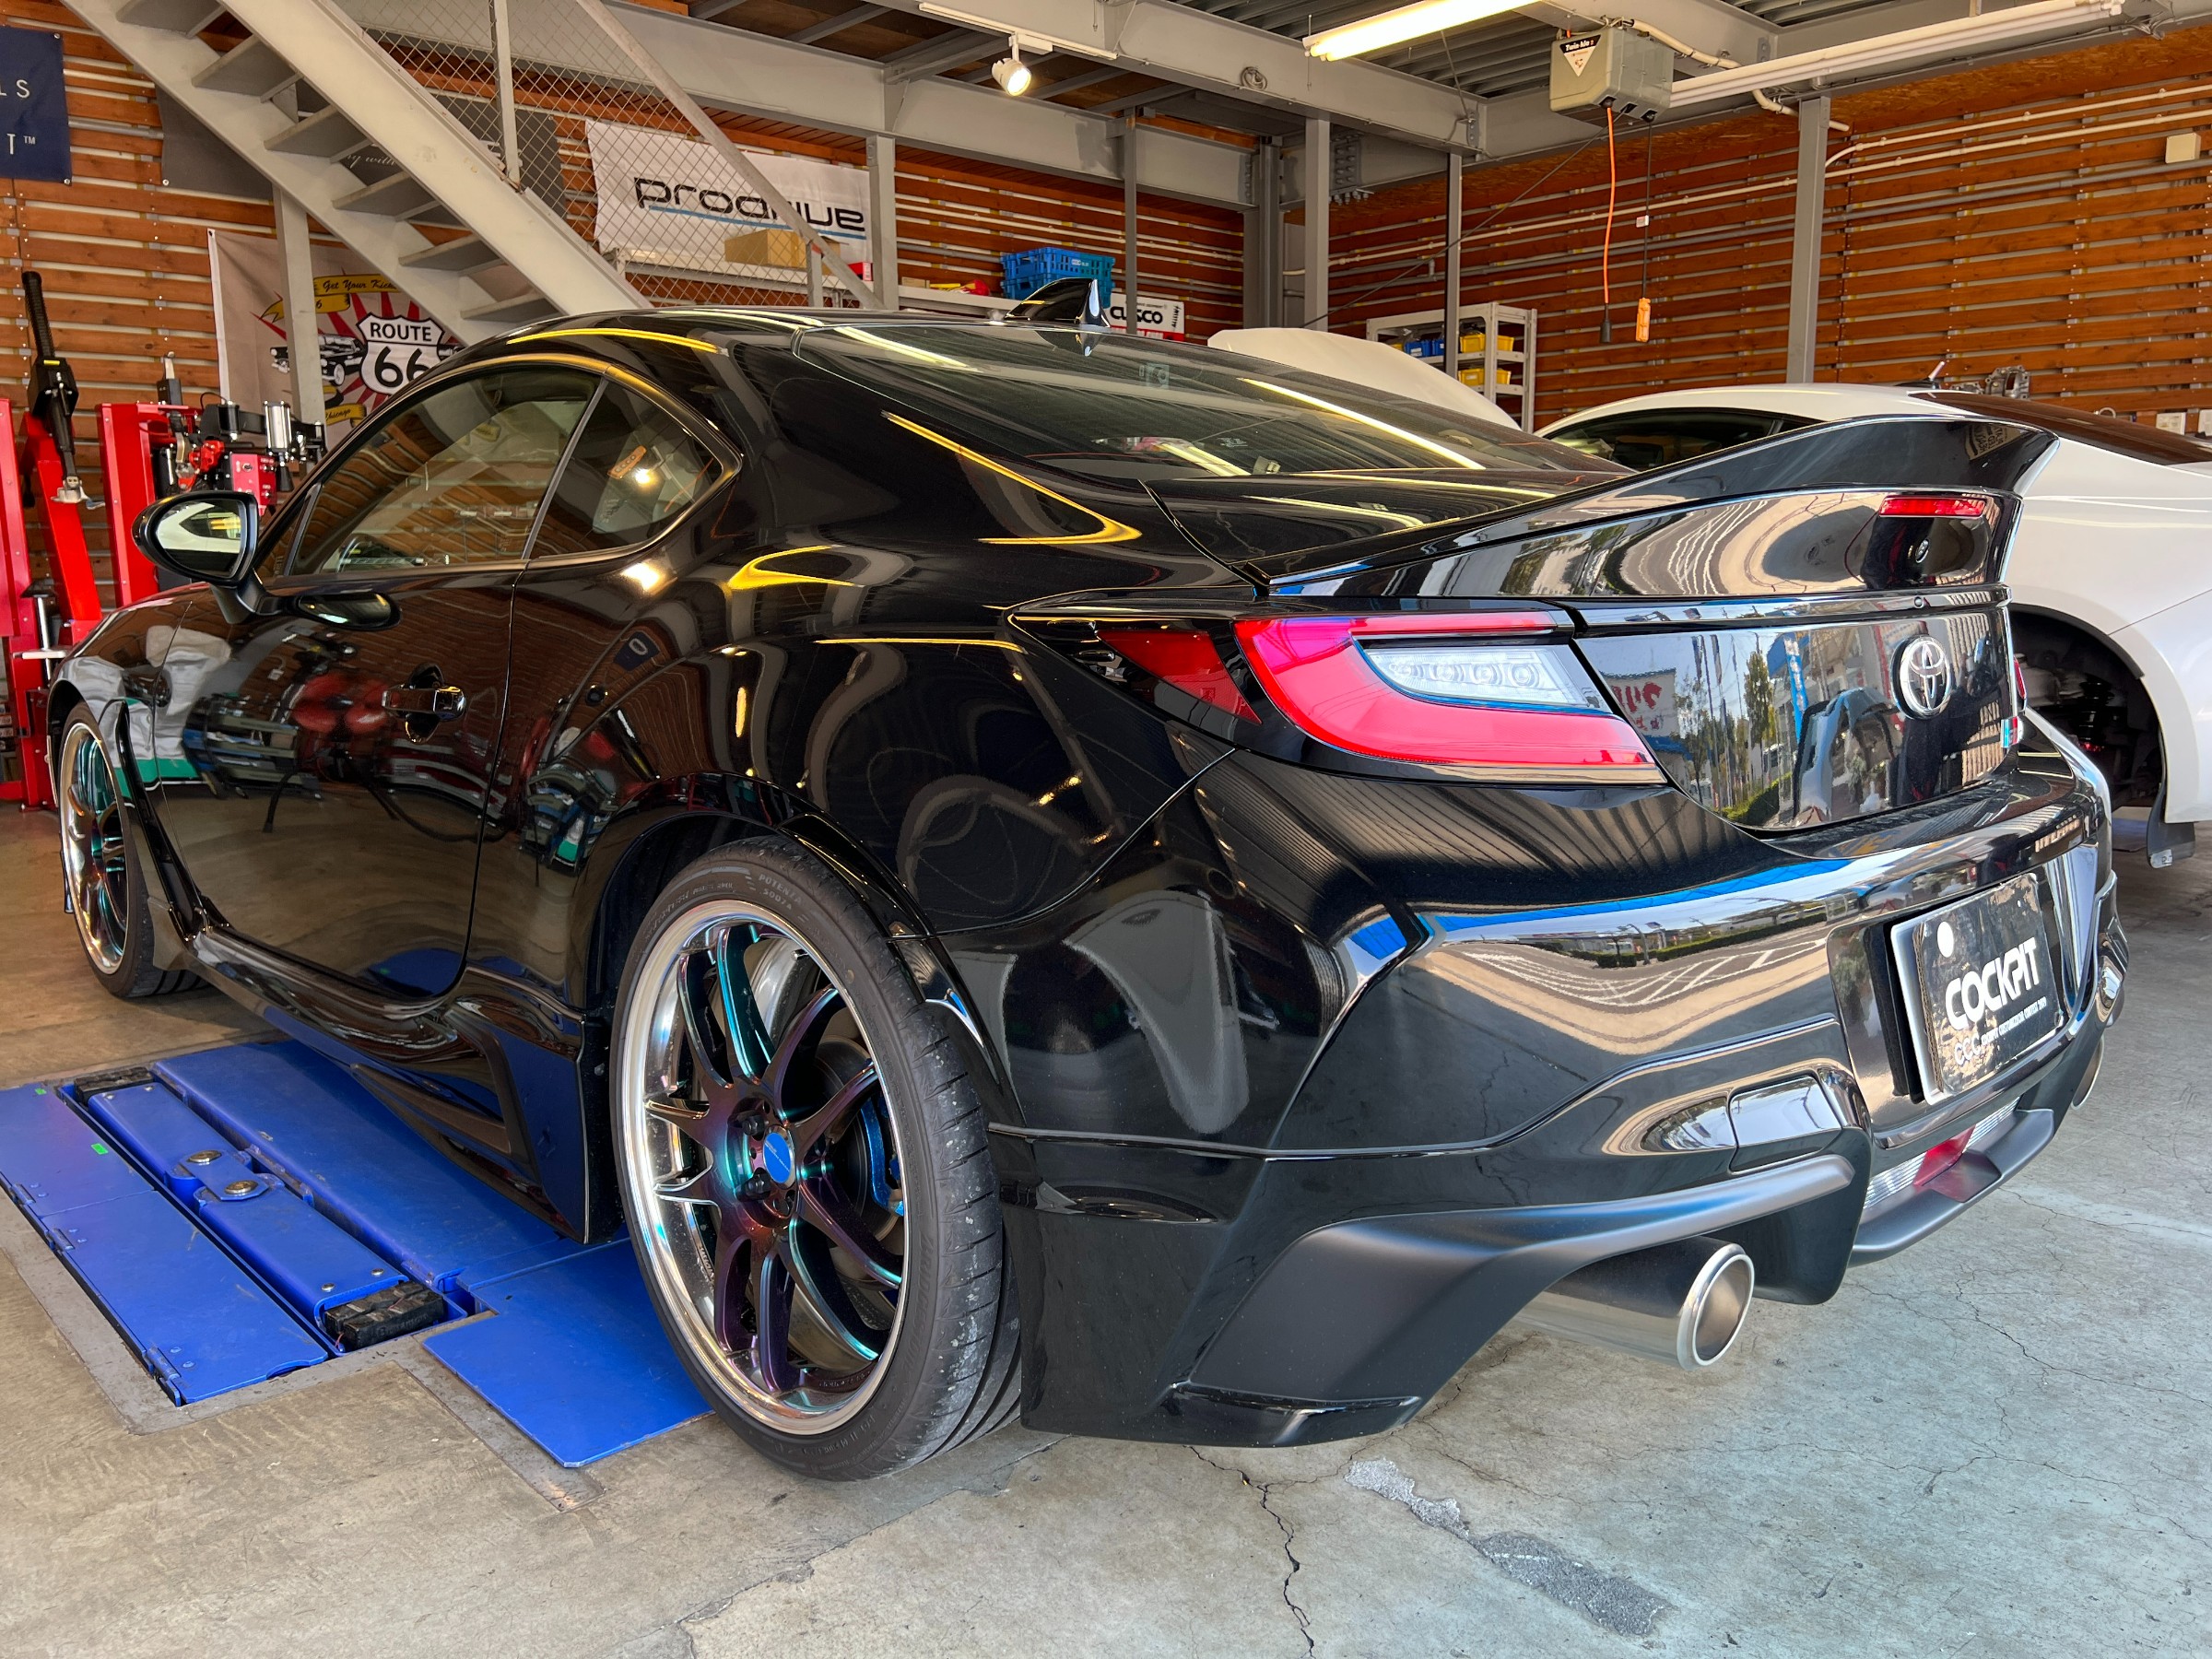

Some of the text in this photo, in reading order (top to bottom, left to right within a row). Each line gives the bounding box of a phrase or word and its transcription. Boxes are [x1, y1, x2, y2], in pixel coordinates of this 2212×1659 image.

[323, 280, 339, 292] Get
[343, 279, 367, 291] Your
[370, 322, 432, 342] ROUTE
[374, 346, 430, 388] 66
[759, 873, 804, 904] POTENZA
[1945, 936, 2040, 1030] COCKPIT
[1954, 1032, 1982, 1065] CCC
